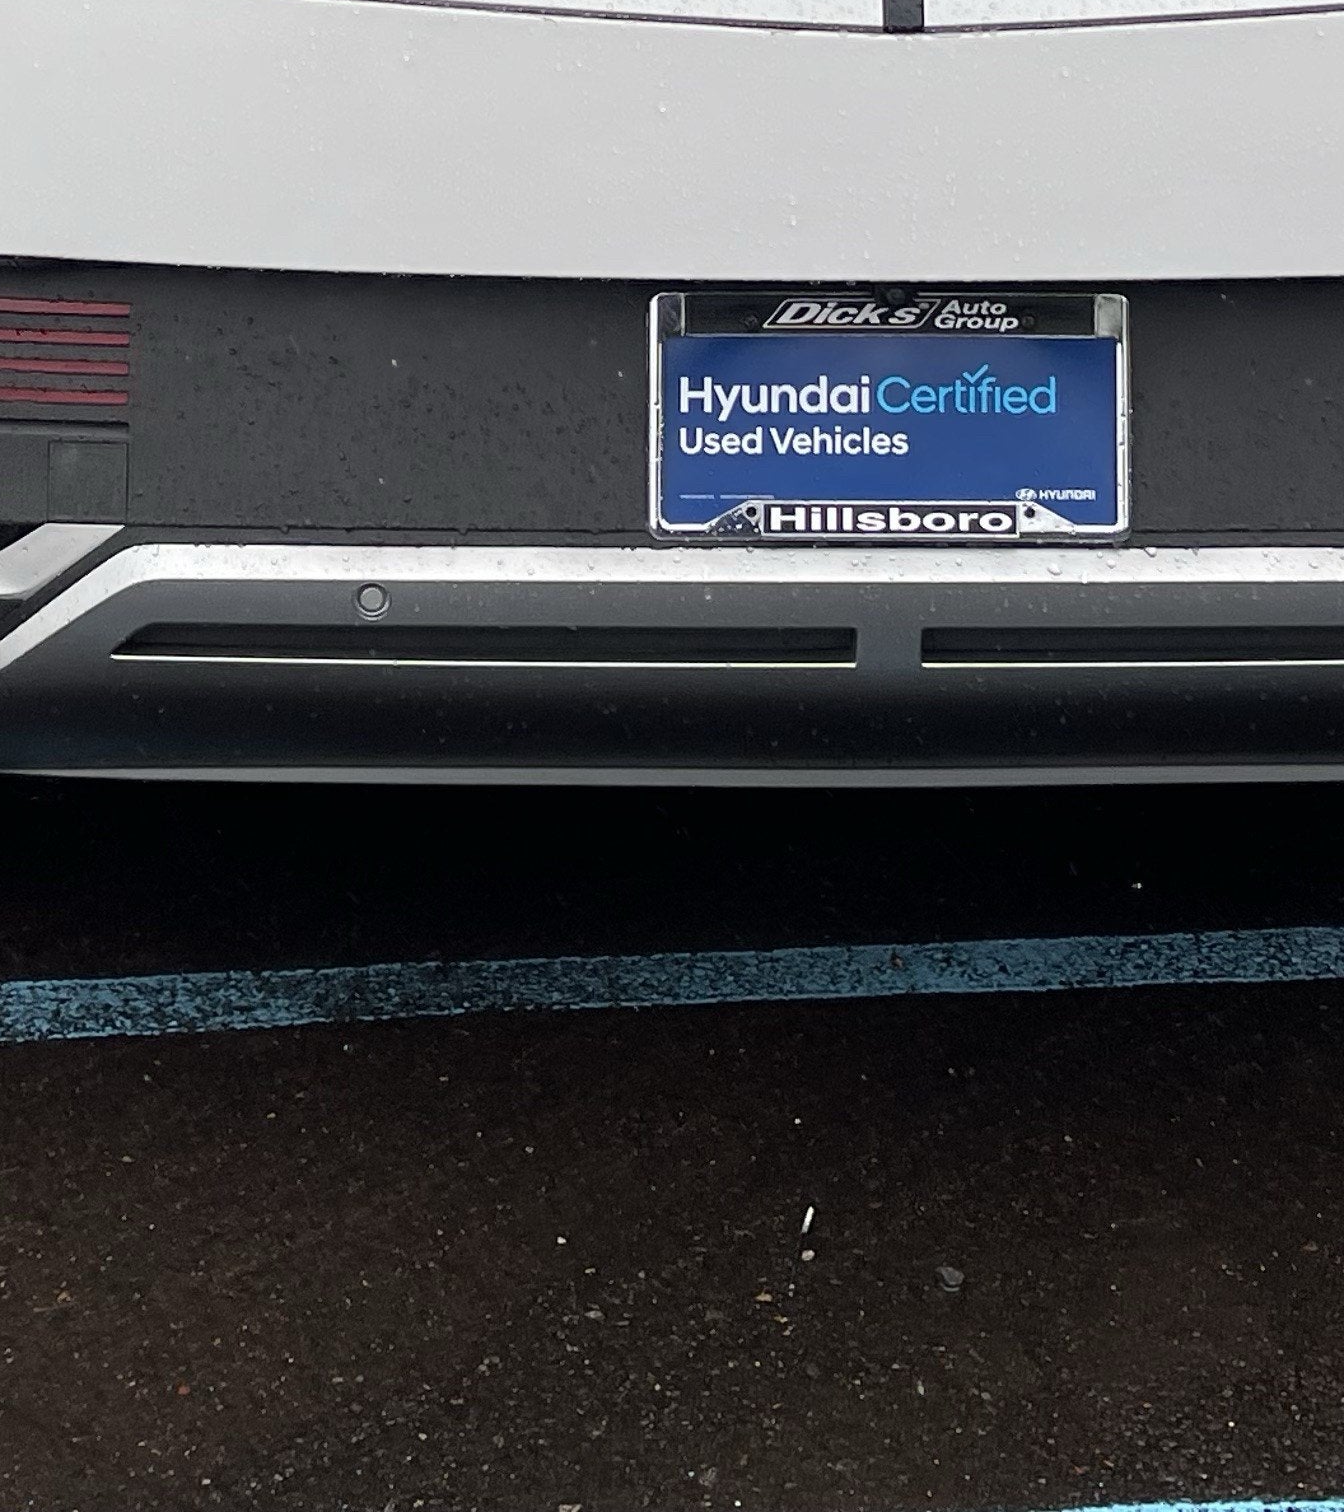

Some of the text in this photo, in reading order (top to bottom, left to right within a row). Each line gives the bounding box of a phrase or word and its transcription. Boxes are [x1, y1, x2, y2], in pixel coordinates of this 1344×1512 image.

[940, 299, 1007, 316] Auto
[934, 313, 1019, 332] Group
[678, 364, 1057, 422] Hyundai Certified
[679, 426, 909, 455] Used Vehicles
[1039, 489, 1096, 501] HYUNDAI
[770, 506, 1013, 532] Hillsboro
